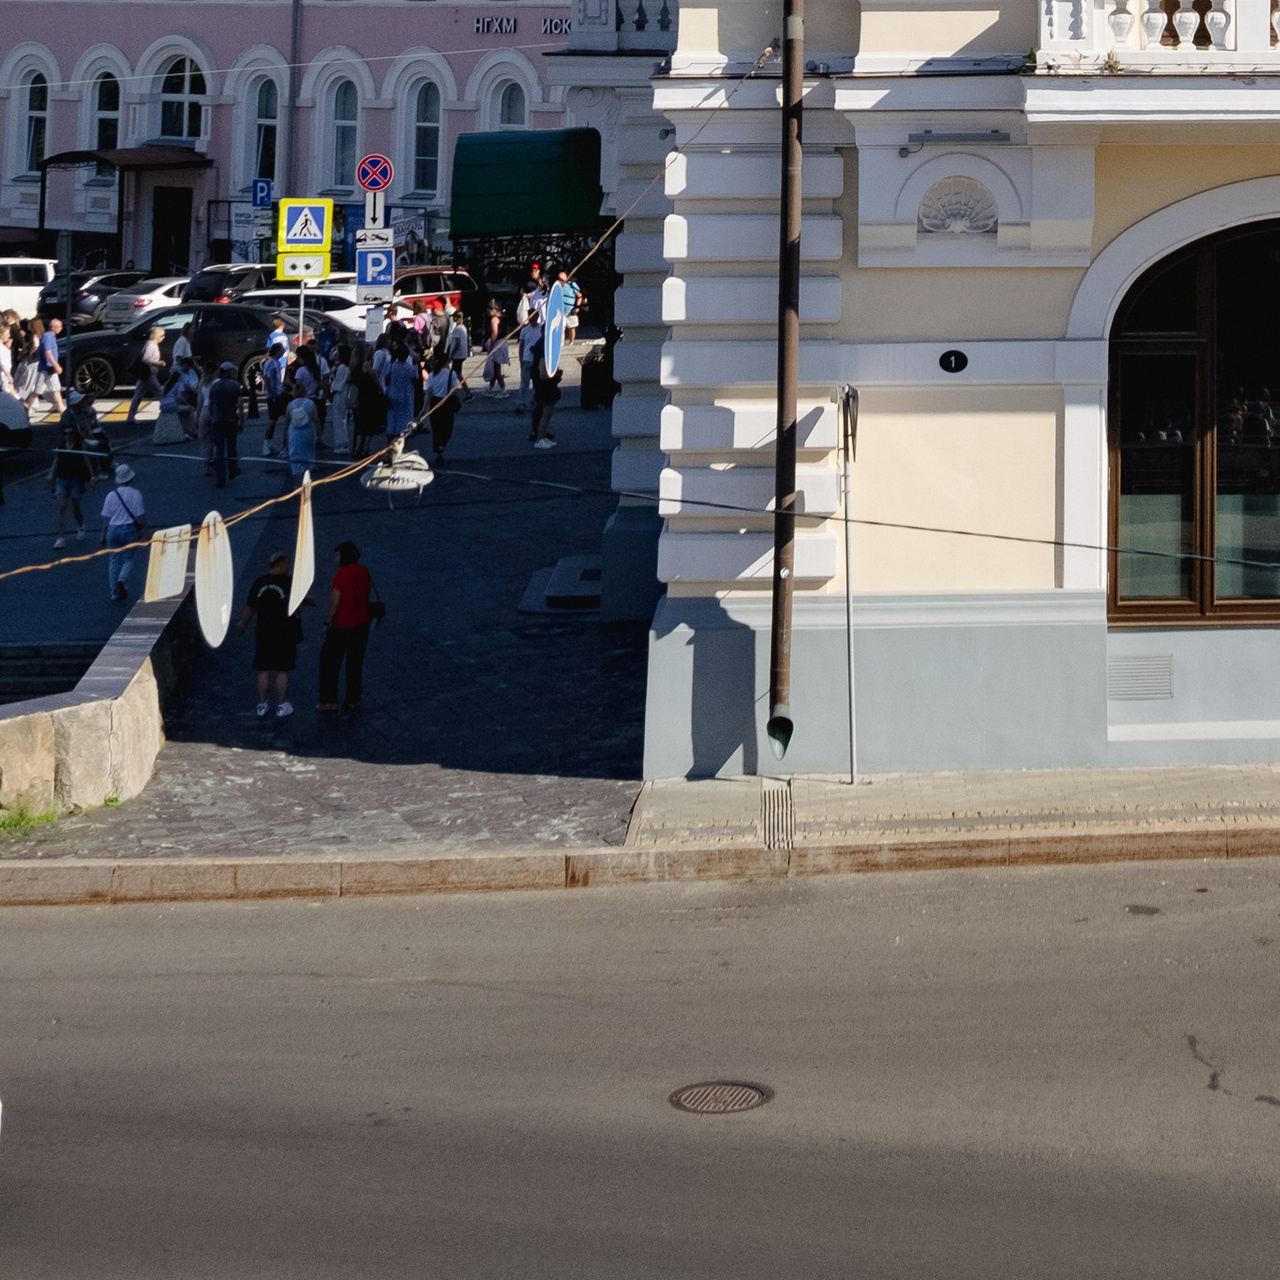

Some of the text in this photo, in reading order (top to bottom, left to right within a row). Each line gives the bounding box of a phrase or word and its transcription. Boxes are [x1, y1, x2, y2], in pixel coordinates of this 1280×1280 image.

[474, 17, 516, 34] НГХМ
[257, 182, 268, 205] P
[366, 252, 388, 283] P
[949, 355, 955, 368] 1
